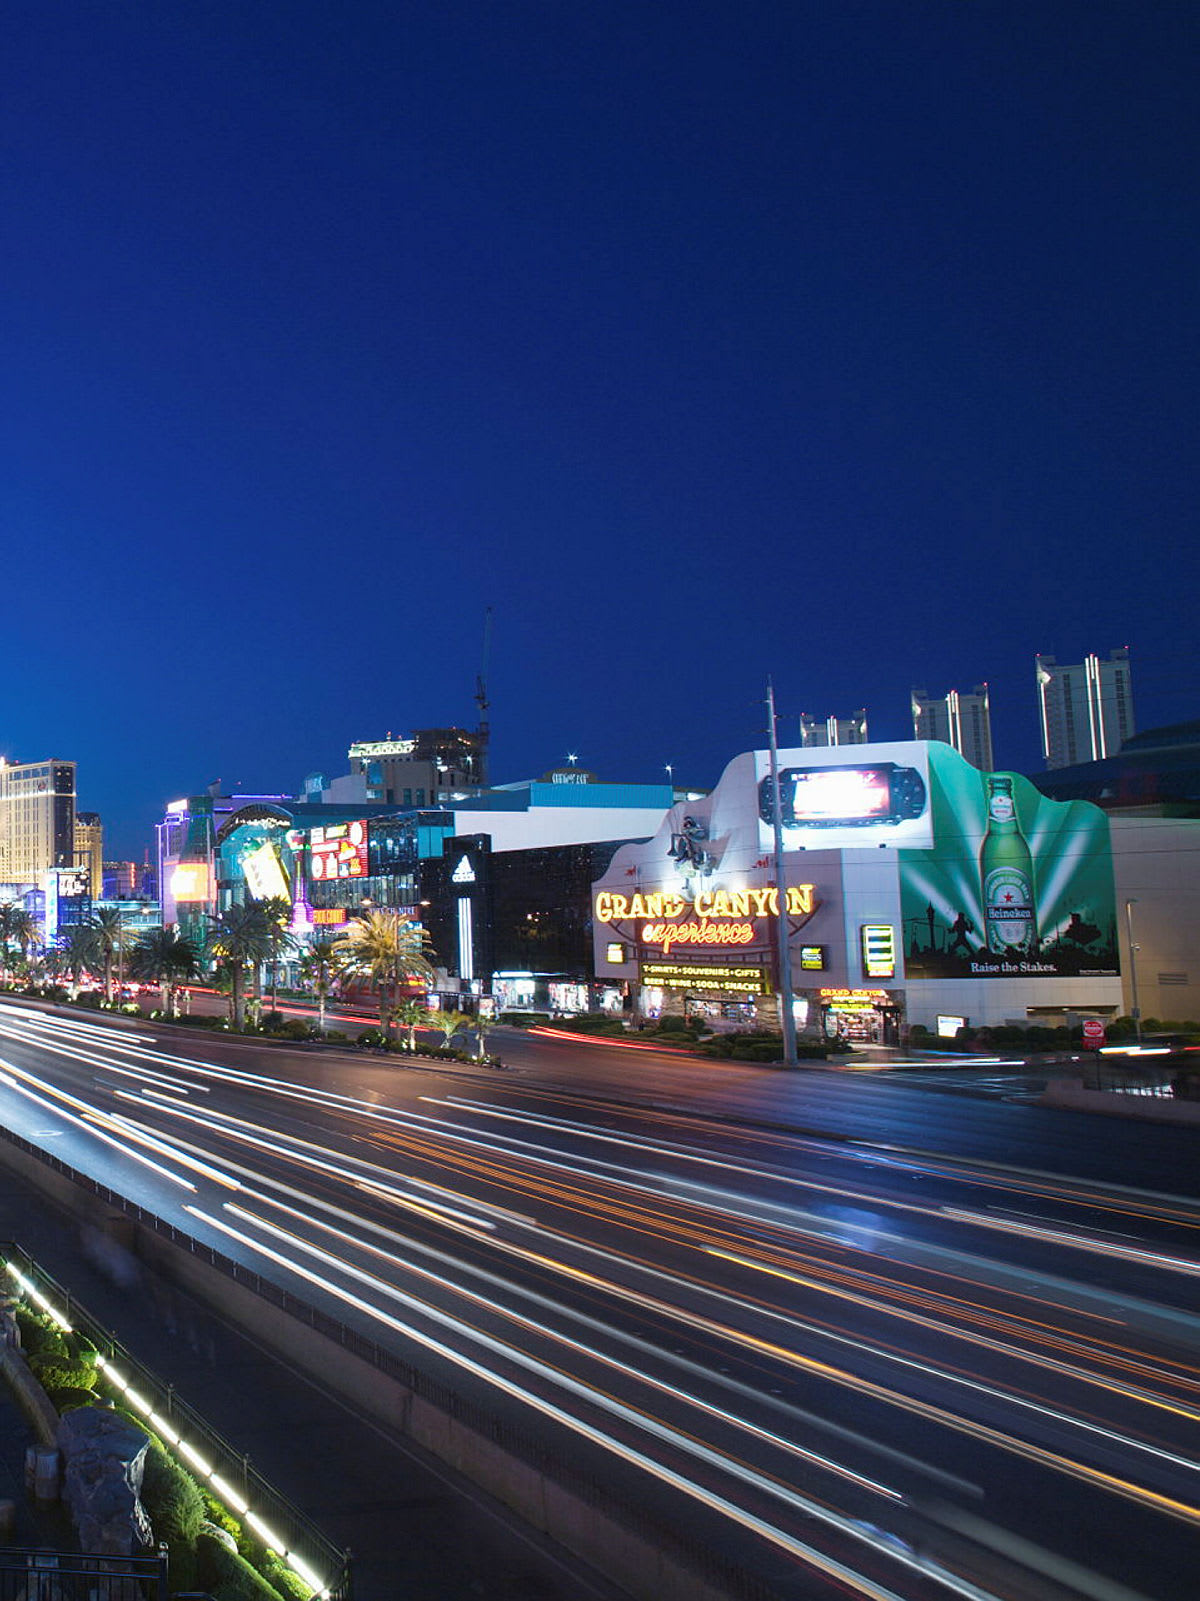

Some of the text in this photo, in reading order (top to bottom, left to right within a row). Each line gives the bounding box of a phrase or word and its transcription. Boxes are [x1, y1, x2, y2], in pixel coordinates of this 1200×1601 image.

[595, 883, 816, 923] GRAND CANYON
[988, 908, 1031, 918] Heineken
[642, 918, 755, 954] experience
[643, 965, 761, 978] T-SHIRTS SOUVENIRS GIFTS
[971, 962, 1058, 973] Raise the Stakes.
[724, 981, 762, 992] SNACKS
